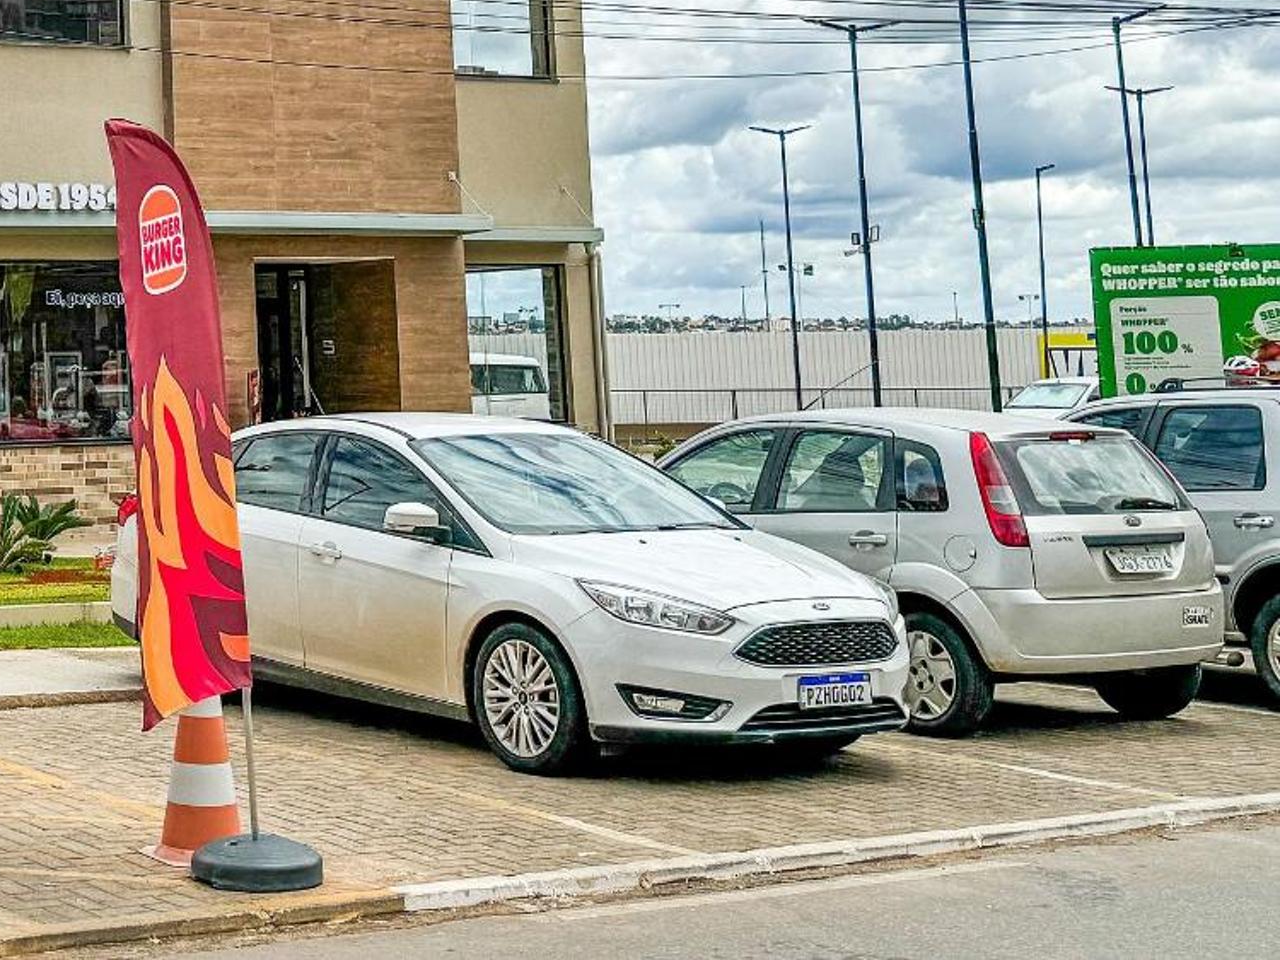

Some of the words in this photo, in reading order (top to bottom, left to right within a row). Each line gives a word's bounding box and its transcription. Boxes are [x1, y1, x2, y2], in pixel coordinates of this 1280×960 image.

[141, 215, 181, 244] BURGER
[143, 236, 184, 274] KING
[1100, 263, 1138, 277] Quer
[1141, 261, 1184, 274] saber
[1186, 264, 1196, 272] o
[1197, 258, 1260, 274] segredo
[1185, 279, 1210, 289] ser
[1122, 330, 1178, 355] 100
